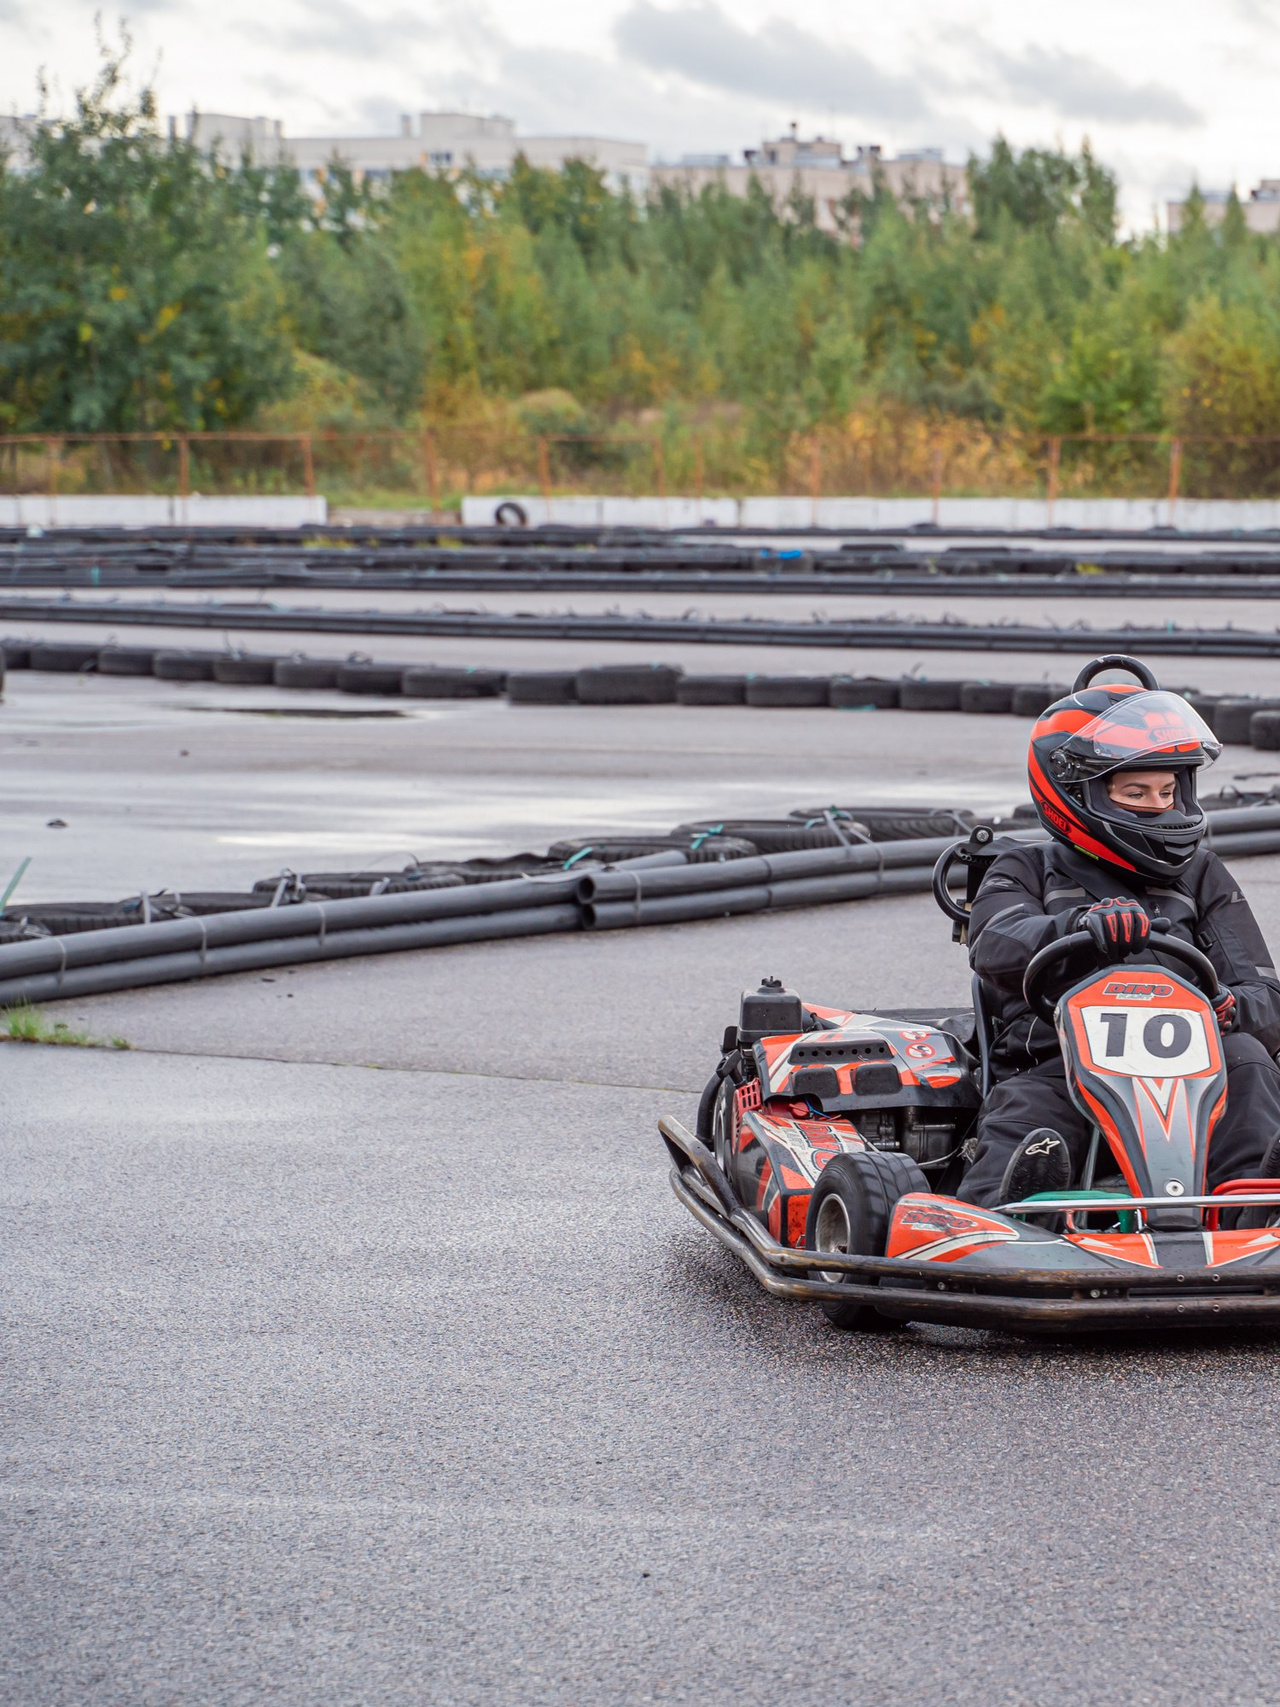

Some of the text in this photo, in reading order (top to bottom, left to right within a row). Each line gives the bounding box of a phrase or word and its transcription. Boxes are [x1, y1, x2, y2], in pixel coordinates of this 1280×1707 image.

[1043, 803, 1068, 831] SHOEI
[1103, 983, 1173, 996] DINO
[1099, 1012, 1193, 1059] 10
